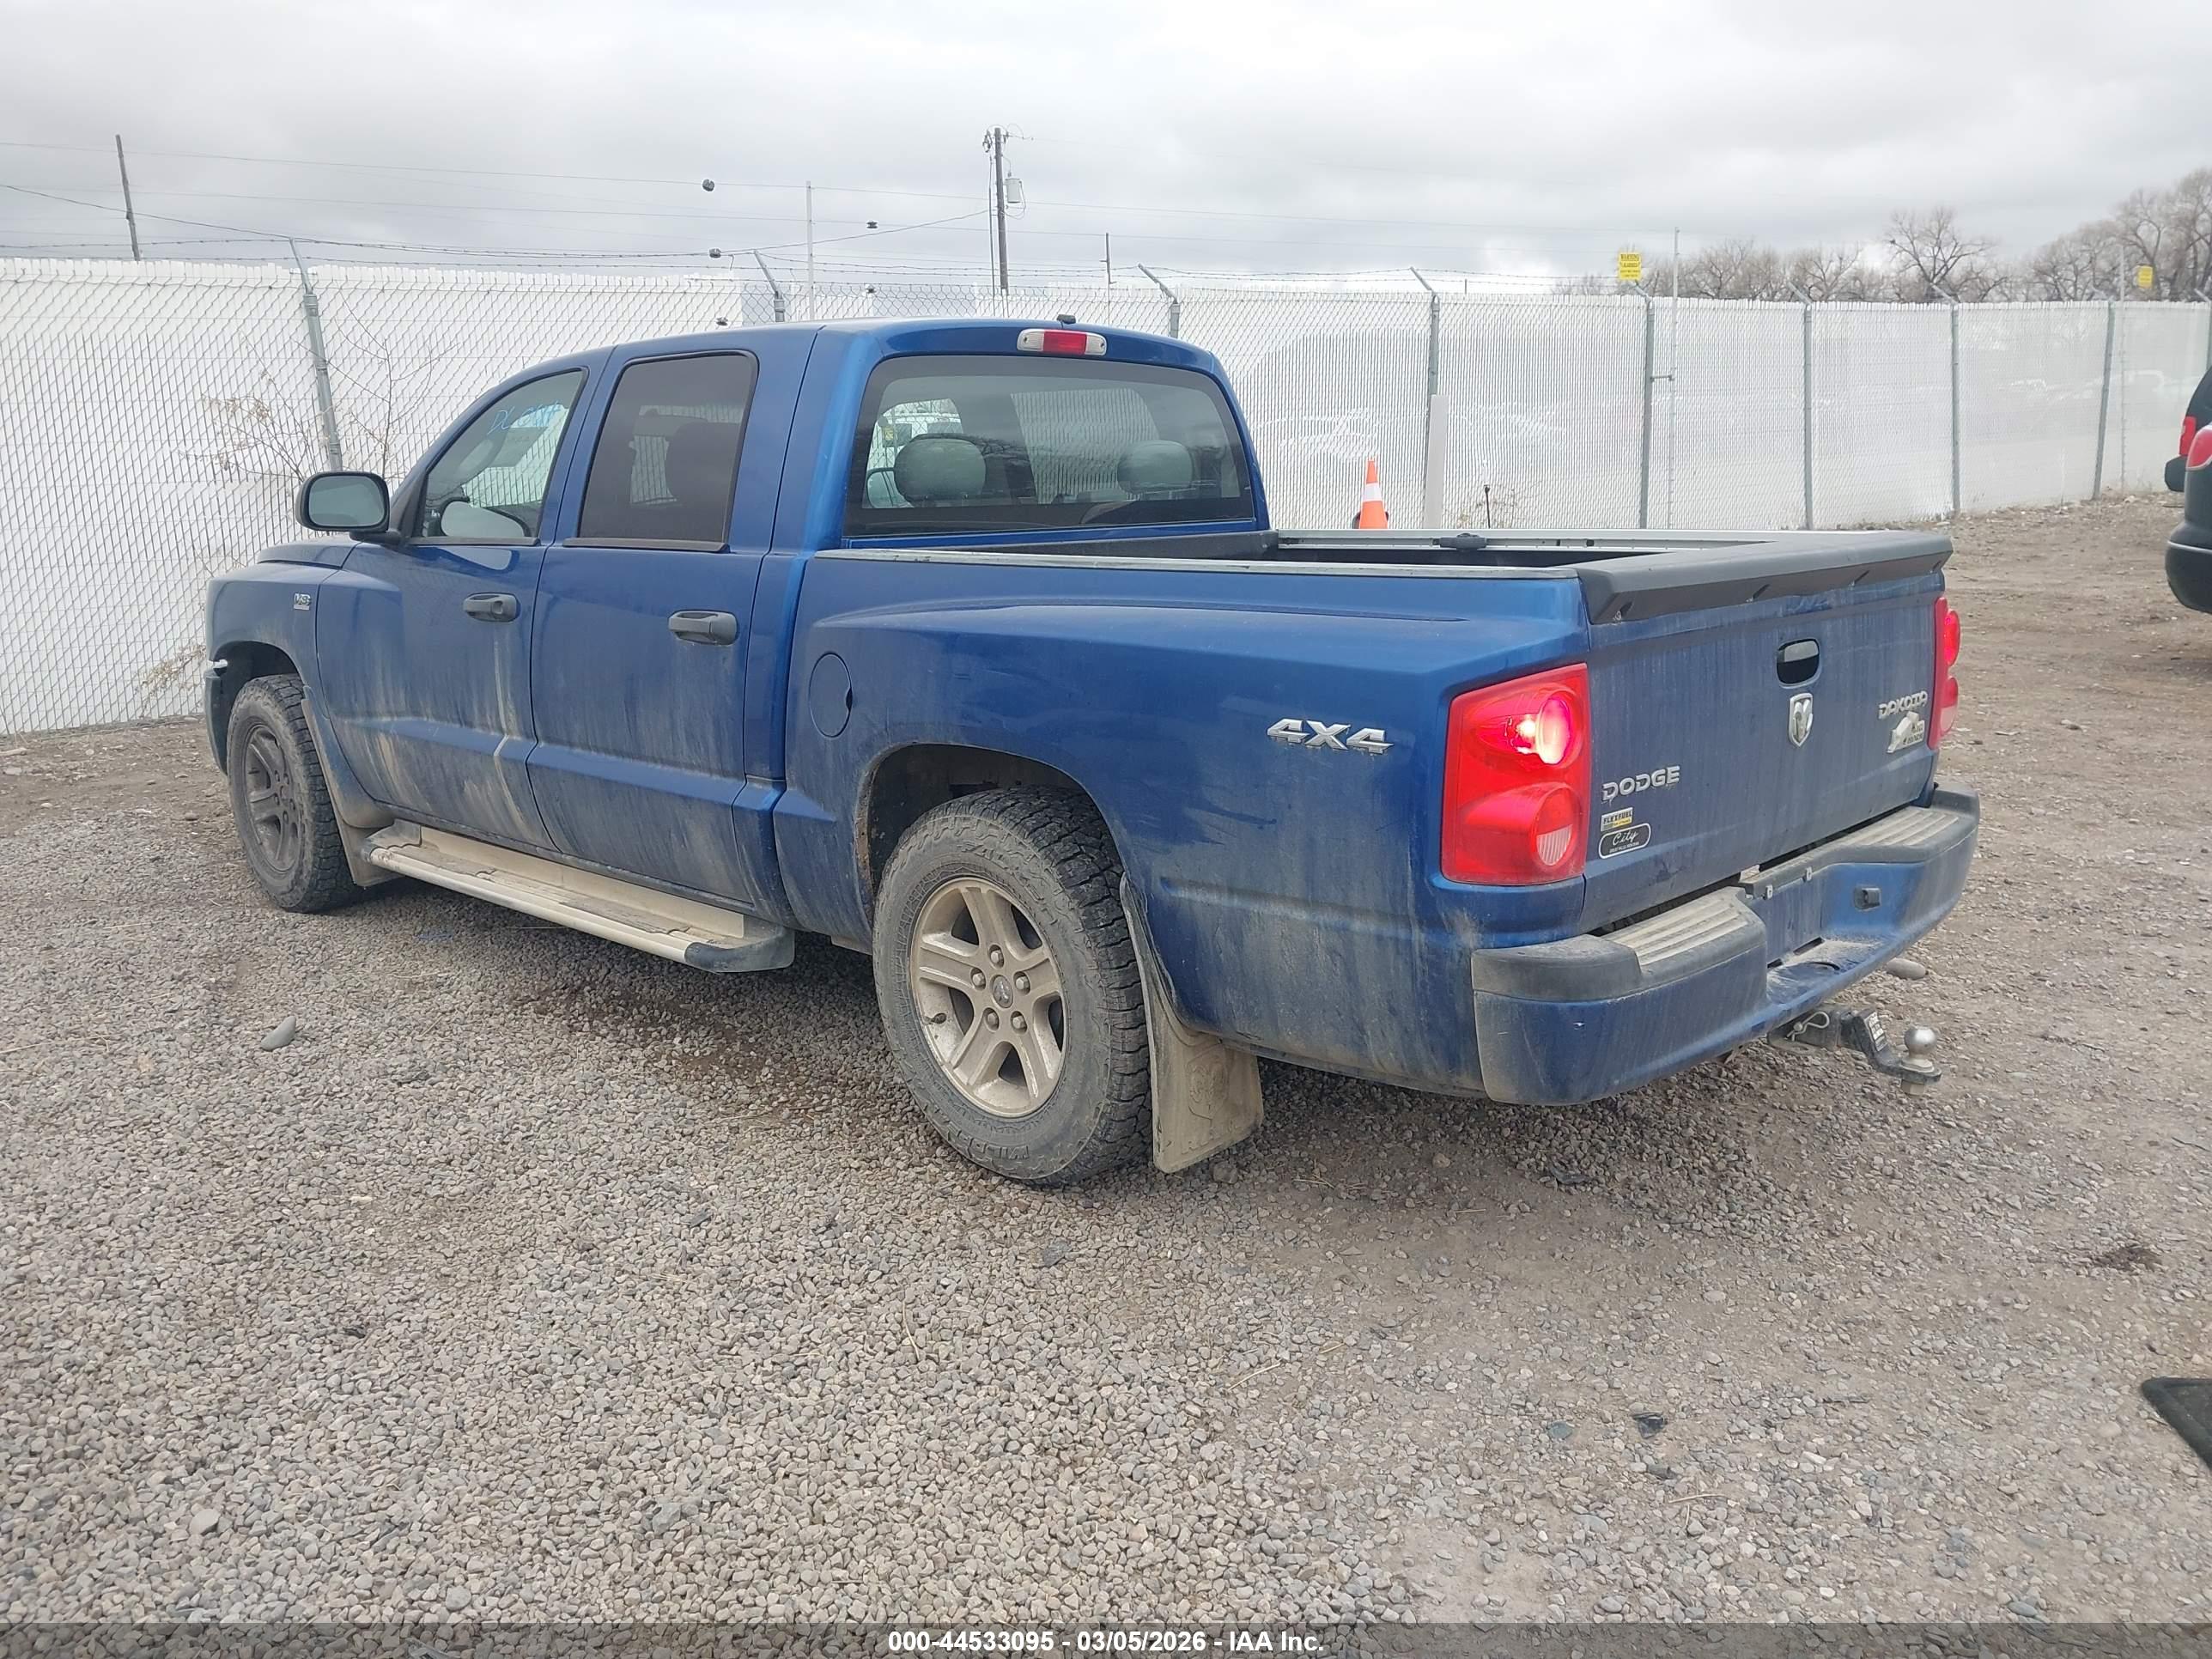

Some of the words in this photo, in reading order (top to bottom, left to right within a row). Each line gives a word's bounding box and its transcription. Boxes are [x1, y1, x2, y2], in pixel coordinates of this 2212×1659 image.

[1878, 690, 1928, 720] DAKOTA
[1601, 765, 1680, 801] DODGE
[1613, 830, 1639, 846] City
